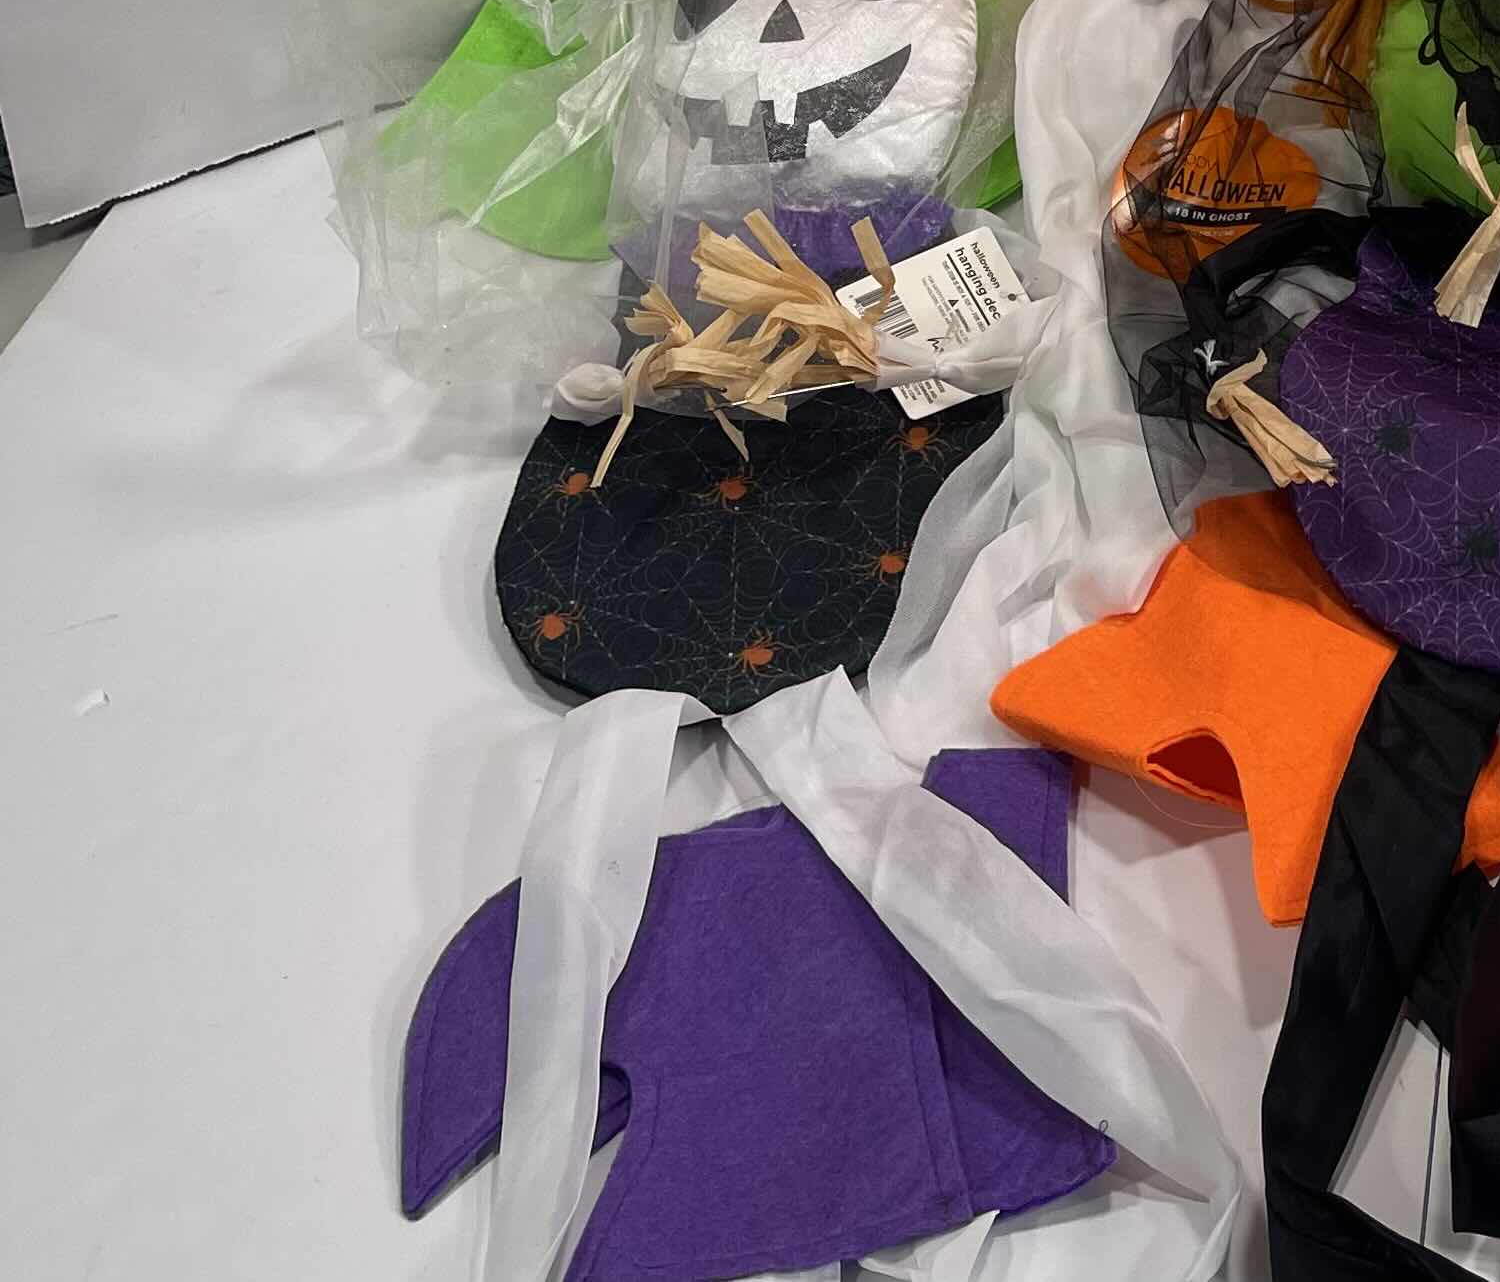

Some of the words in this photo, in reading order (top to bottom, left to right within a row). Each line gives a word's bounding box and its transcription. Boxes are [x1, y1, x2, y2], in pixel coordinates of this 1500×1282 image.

[1168, 167, 1287, 204] ALLOWEEN
[1175, 207, 1189, 218] 18
[1192, 210, 1205, 221] IN
[1209, 212, 1251, 222] GHOST
[954, 247, 987, 296] hanging
[984, 297, 1001, 320] dec
[971, 241, 1000, 289] halloween
